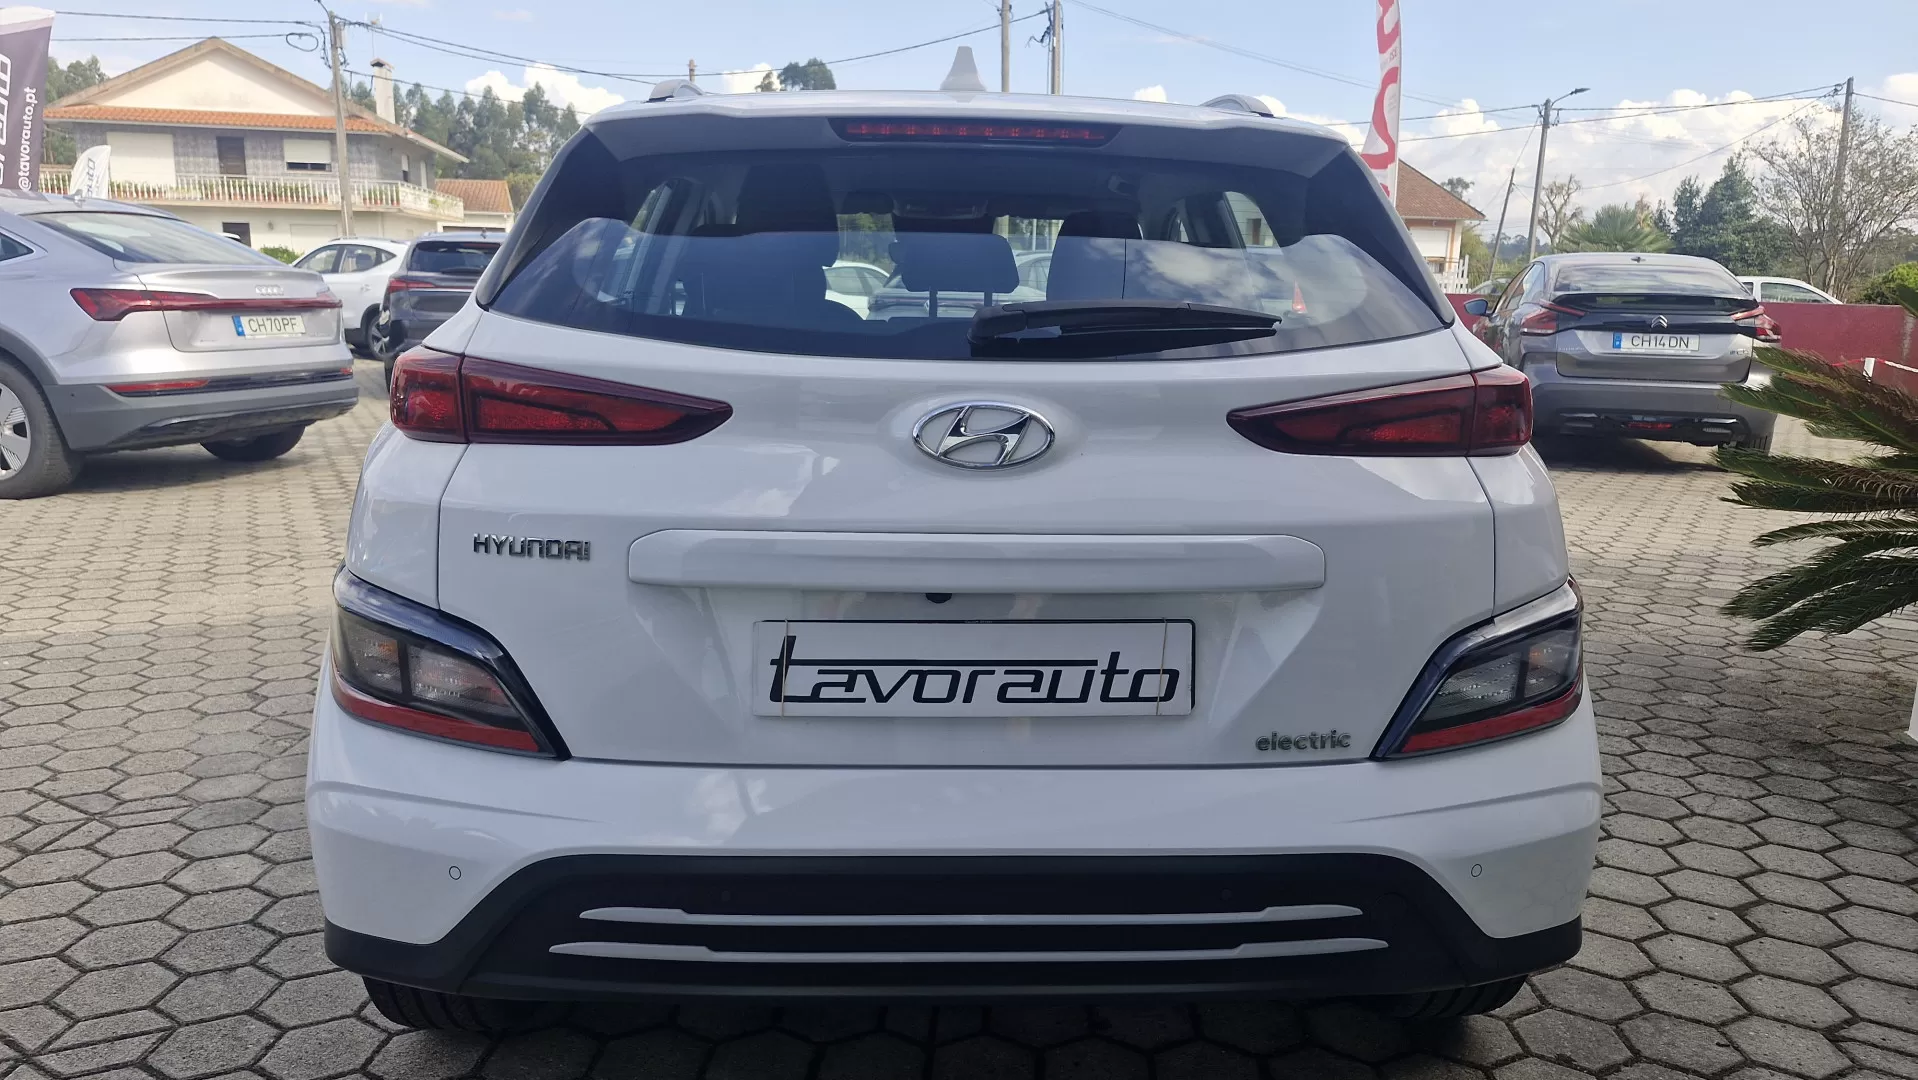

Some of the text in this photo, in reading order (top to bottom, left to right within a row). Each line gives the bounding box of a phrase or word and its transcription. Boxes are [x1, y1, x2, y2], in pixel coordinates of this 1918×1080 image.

[18, 86, 38, 192] @tavorauto.pt
[248, 317, 298, 333] CH70PF
[473, 533, 591, 561] HYUNDAI
[769, 635, 1180, 704] tavorauto
[1255, 728, 1351, 751] electric
